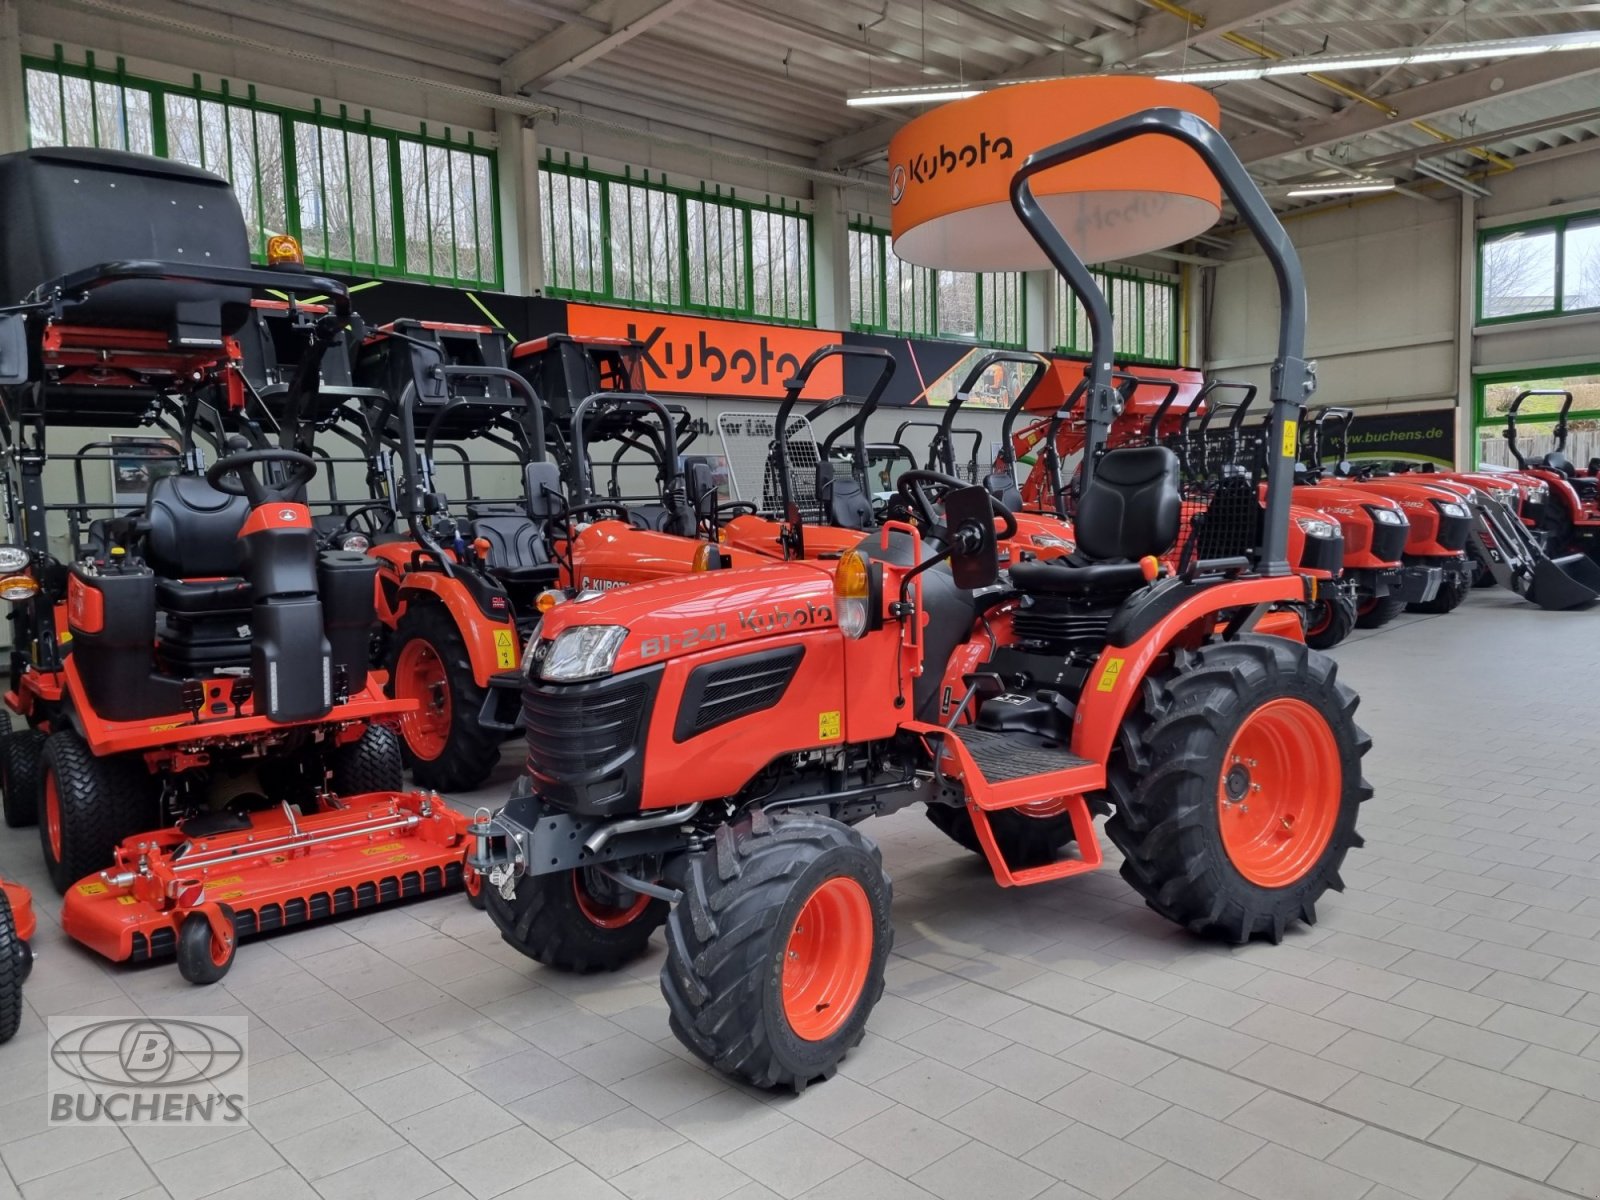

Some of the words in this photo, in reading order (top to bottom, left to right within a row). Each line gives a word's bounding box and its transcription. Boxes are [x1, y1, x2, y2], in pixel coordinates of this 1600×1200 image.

[909, 131, 1013, 184] Kubota
[738, 601, 832, 632] Kubota
[640, 623, 727, 658] B1-241
